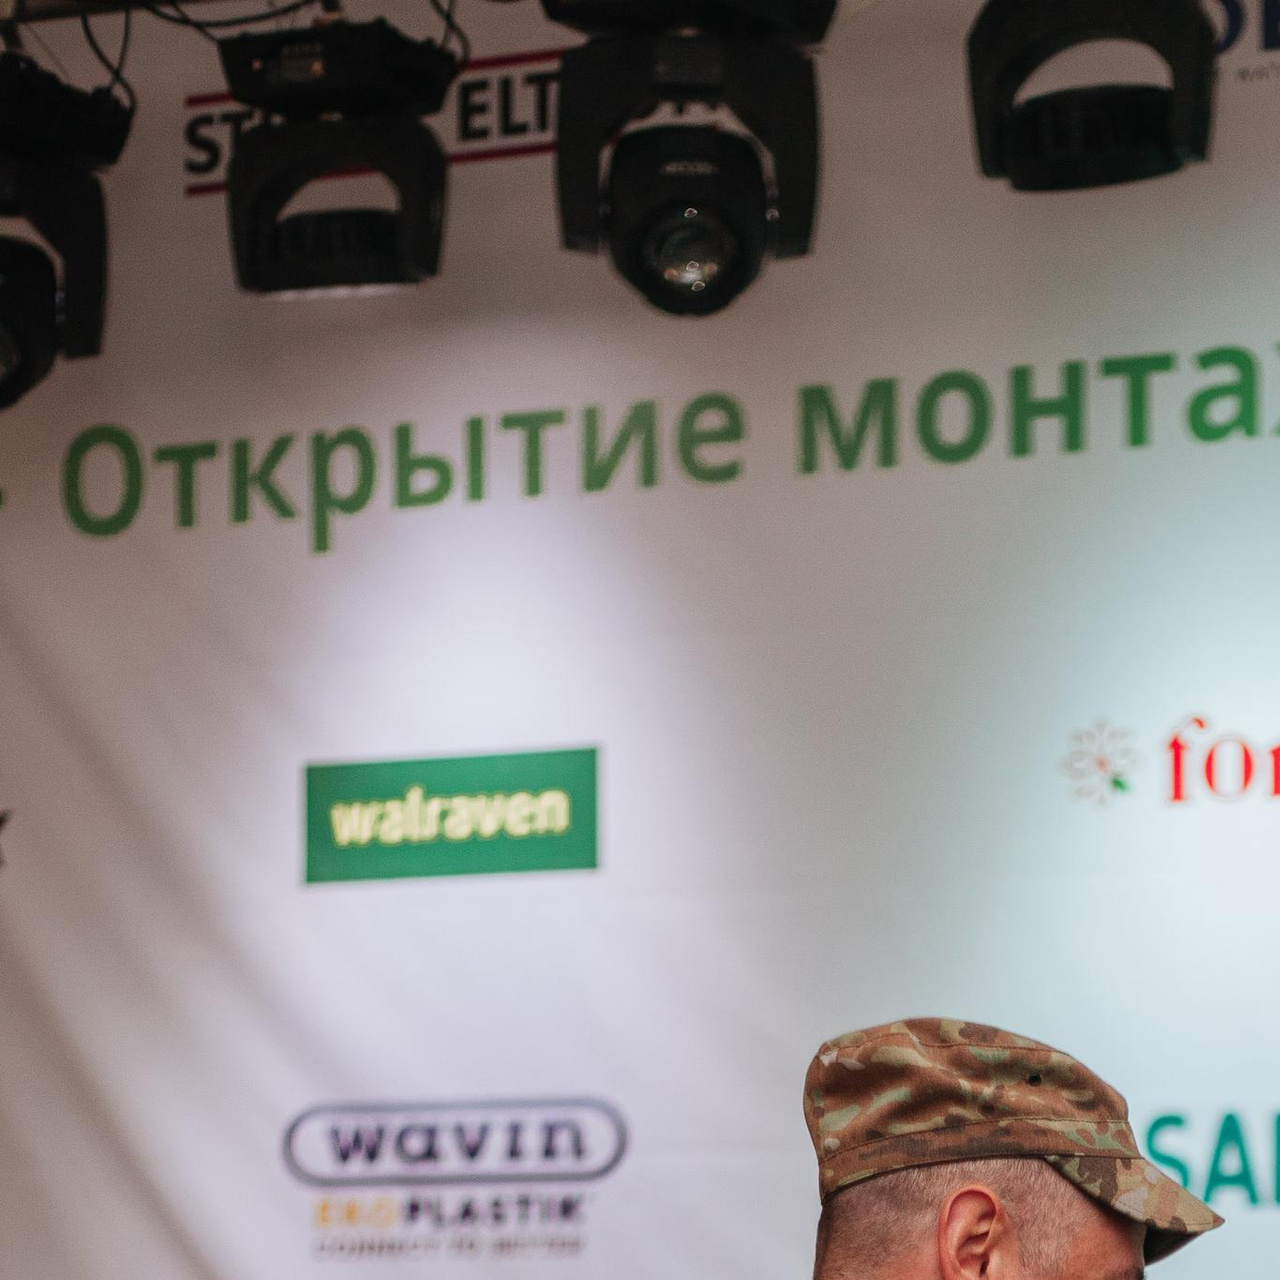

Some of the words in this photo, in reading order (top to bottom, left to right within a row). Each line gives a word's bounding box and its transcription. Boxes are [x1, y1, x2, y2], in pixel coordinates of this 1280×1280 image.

[183, 110, 254, 176] ST
[457, 71, 561, 143] ELT
[62, 390, 746, 555] Открытие
[330, 784, 571, 847] walraven
[327, 1118, 588, 1168] wavin
